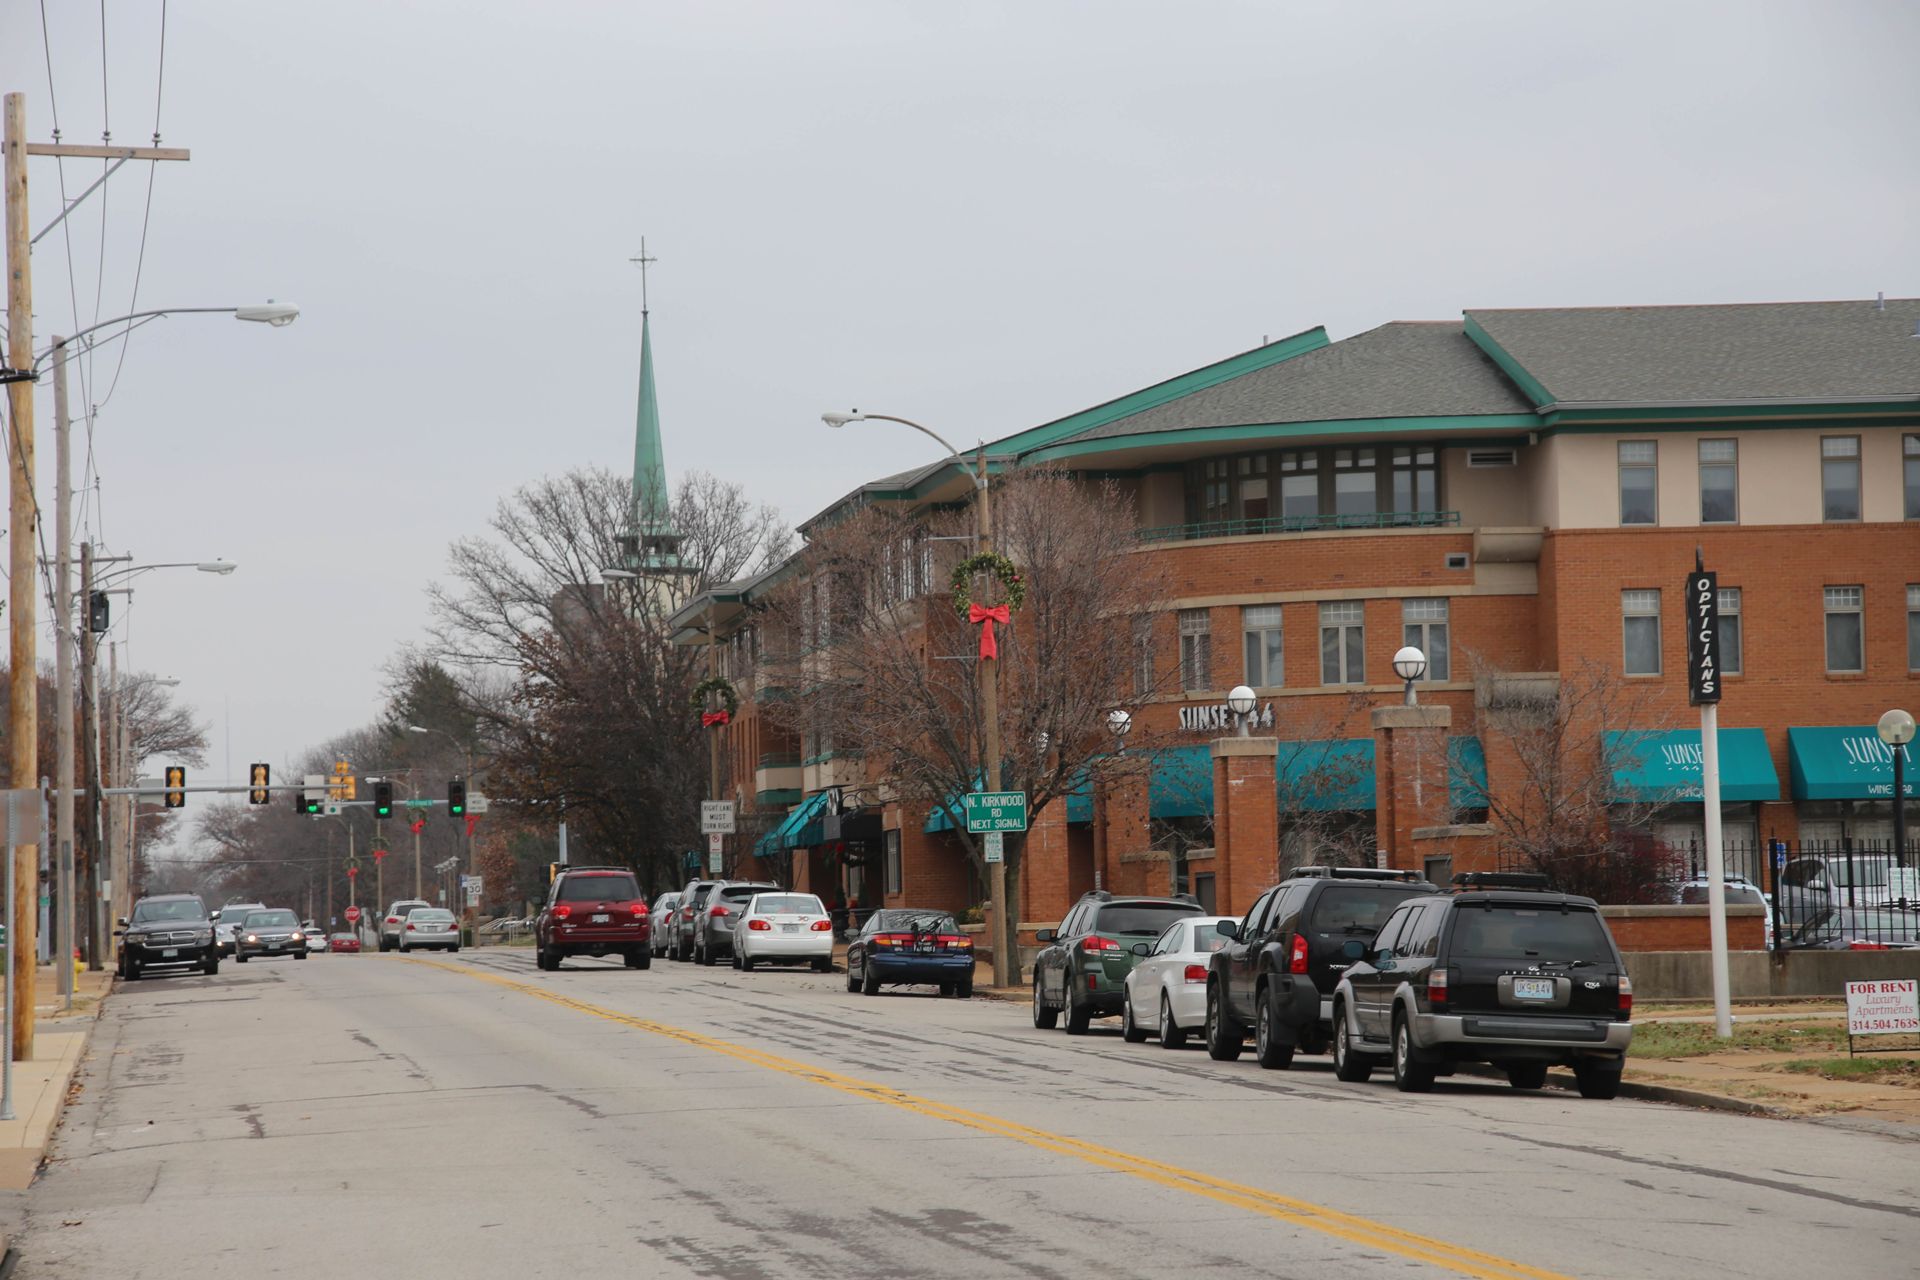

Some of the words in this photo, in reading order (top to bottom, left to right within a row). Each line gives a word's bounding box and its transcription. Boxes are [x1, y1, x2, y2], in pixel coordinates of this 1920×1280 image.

[1697, 579, 1714, 694] OPTICIANS
[1661, 743, 1704, 765] SUNSE
[1867, 784, 1894, 795] WINE
[703, 804, 718, 812] RIGHT
[719, 804, 733, 812] LANE
[968, 797, 978, 808] N.
[981, 795, 1024, 807] KIRKWOOD
[991, 808, 1002, 818] RD
[718, 822, 733, 830] RIGHT
[970, 819, 992, 830] NEXT
[994, 818, 1023, 829] SIGNAL
[469, 885, 481, 894] 30
[1850, 983, 1876, 994] FOR
[1880, 981, 1915, 993] RENT
[1866, 994, 1902, 1007] Luxury
[1855, 1004, 1914, 1019] Apartments
[1851, 1017, 1919, 1031] 314.504.7638
